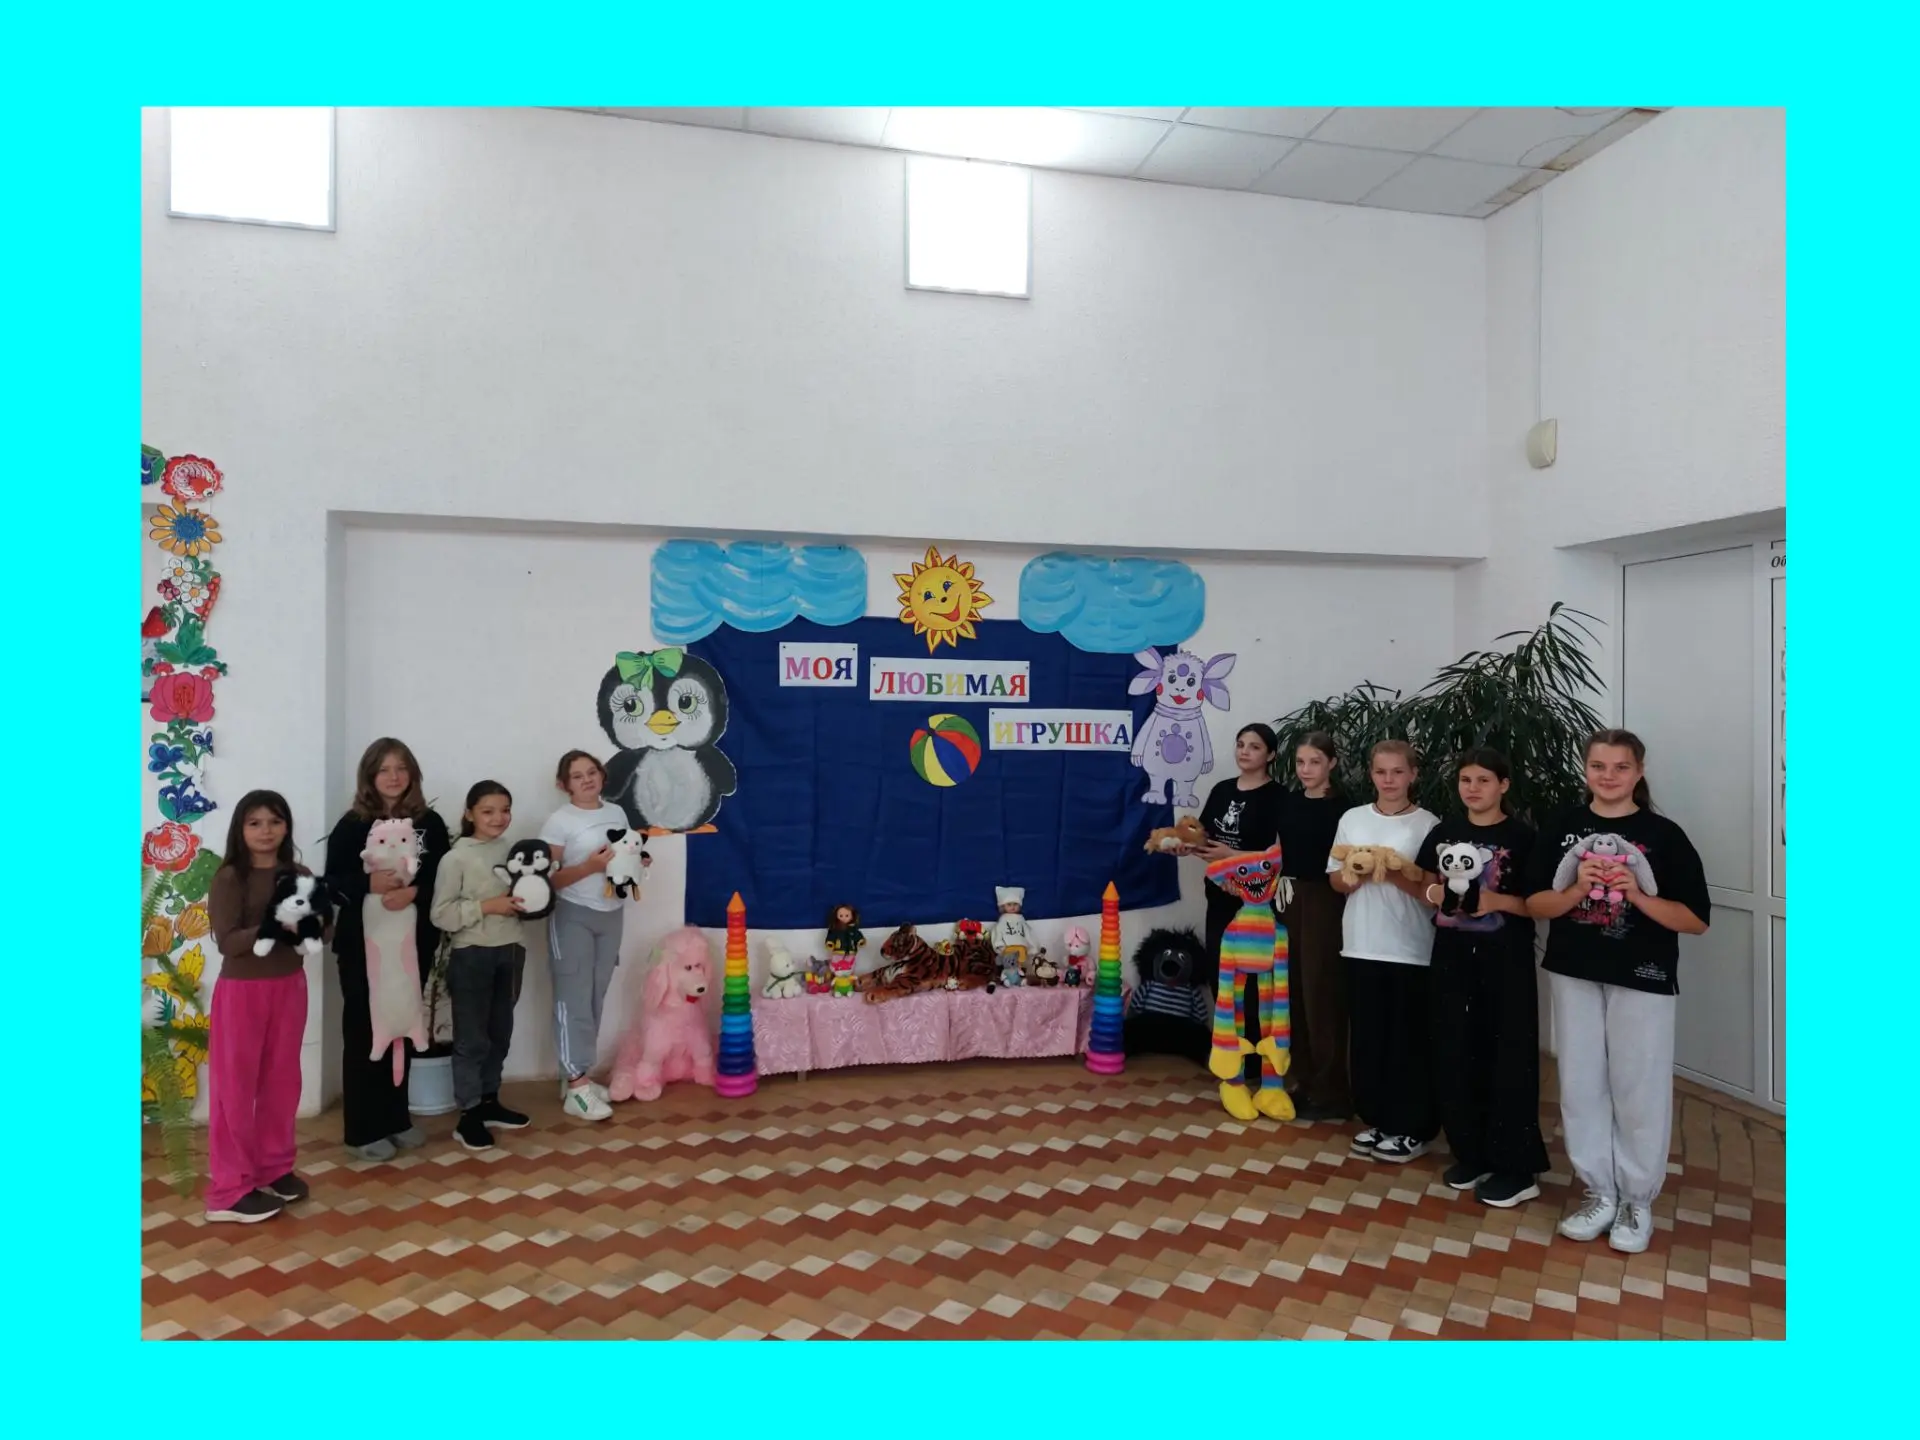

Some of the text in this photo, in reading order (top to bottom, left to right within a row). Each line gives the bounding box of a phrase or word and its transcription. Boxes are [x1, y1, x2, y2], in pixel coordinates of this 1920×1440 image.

[785, 657, 853, 680] МОЯ
[874, 671, 1027, 697] ЛЮБИМАЯ
[995, 722, 1130, 746] ИГРУШКА
